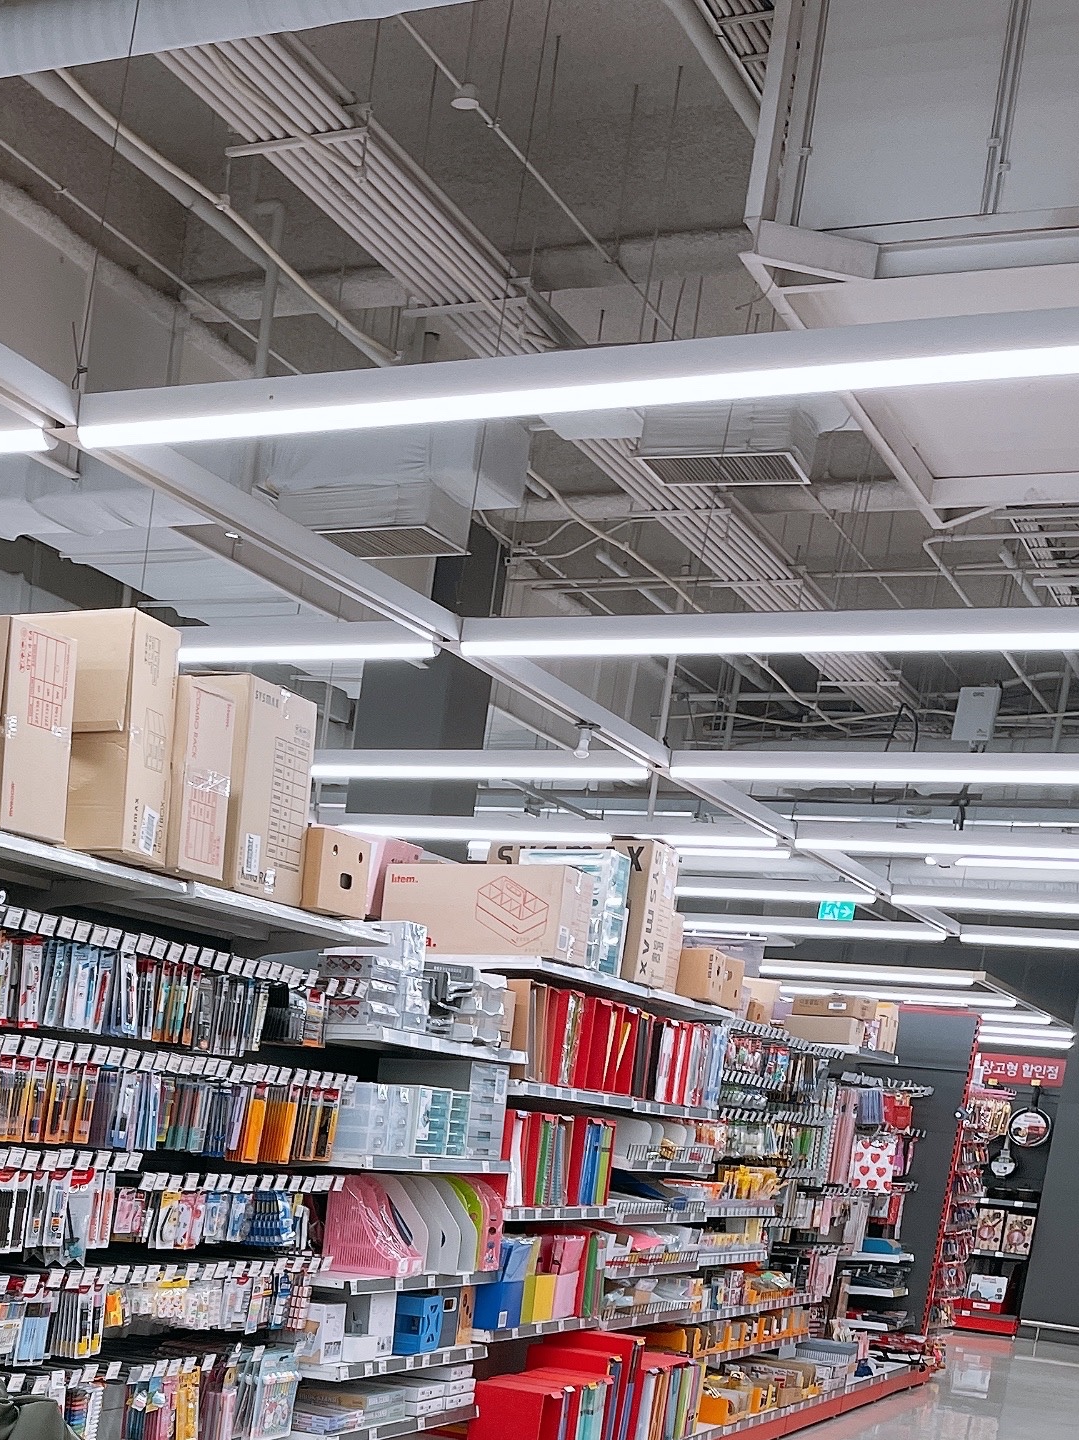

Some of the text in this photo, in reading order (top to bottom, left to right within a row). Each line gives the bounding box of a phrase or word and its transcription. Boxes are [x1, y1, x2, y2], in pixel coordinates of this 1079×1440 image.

[255, 689, 280, 709] SYSMAX
[638, 848, 664, 975] SYSMAX
[982, 1060, 1060, 1080] 창고형 할인점
